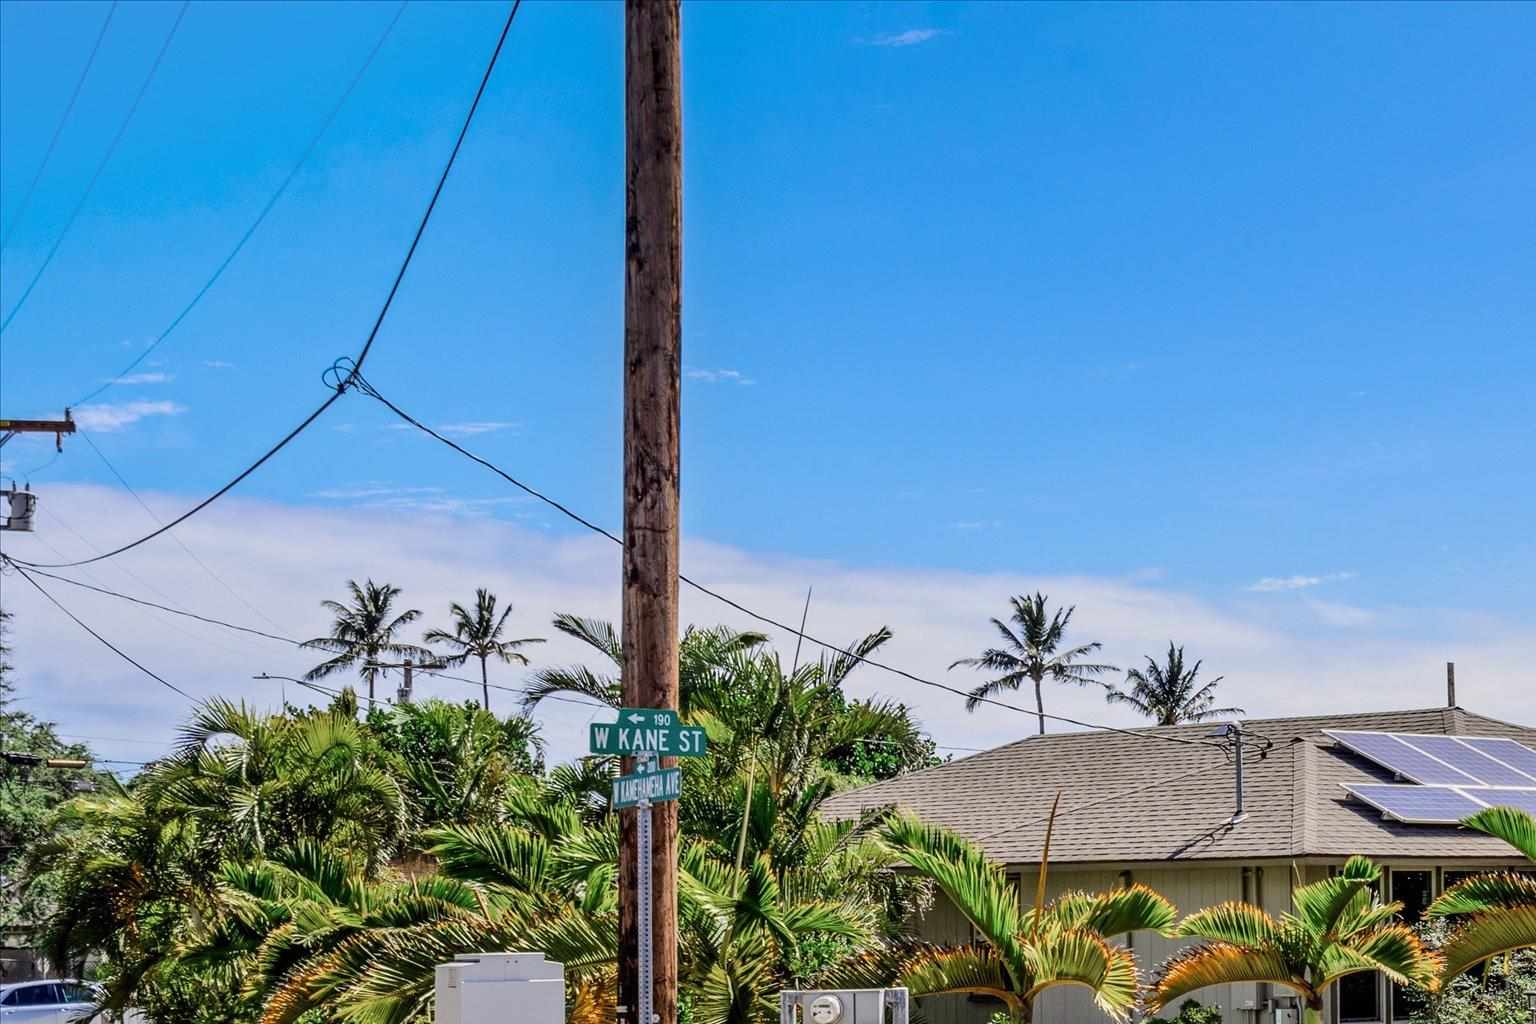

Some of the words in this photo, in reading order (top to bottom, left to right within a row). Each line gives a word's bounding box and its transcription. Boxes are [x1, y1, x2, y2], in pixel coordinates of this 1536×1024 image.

[654, 714, 671, 726] 190
[594, 727, 609, 749] W
[618, 728, 670, 751] KANE
[679, 730, 702, 753] ST
[664, 771, 680, 797] AVE
